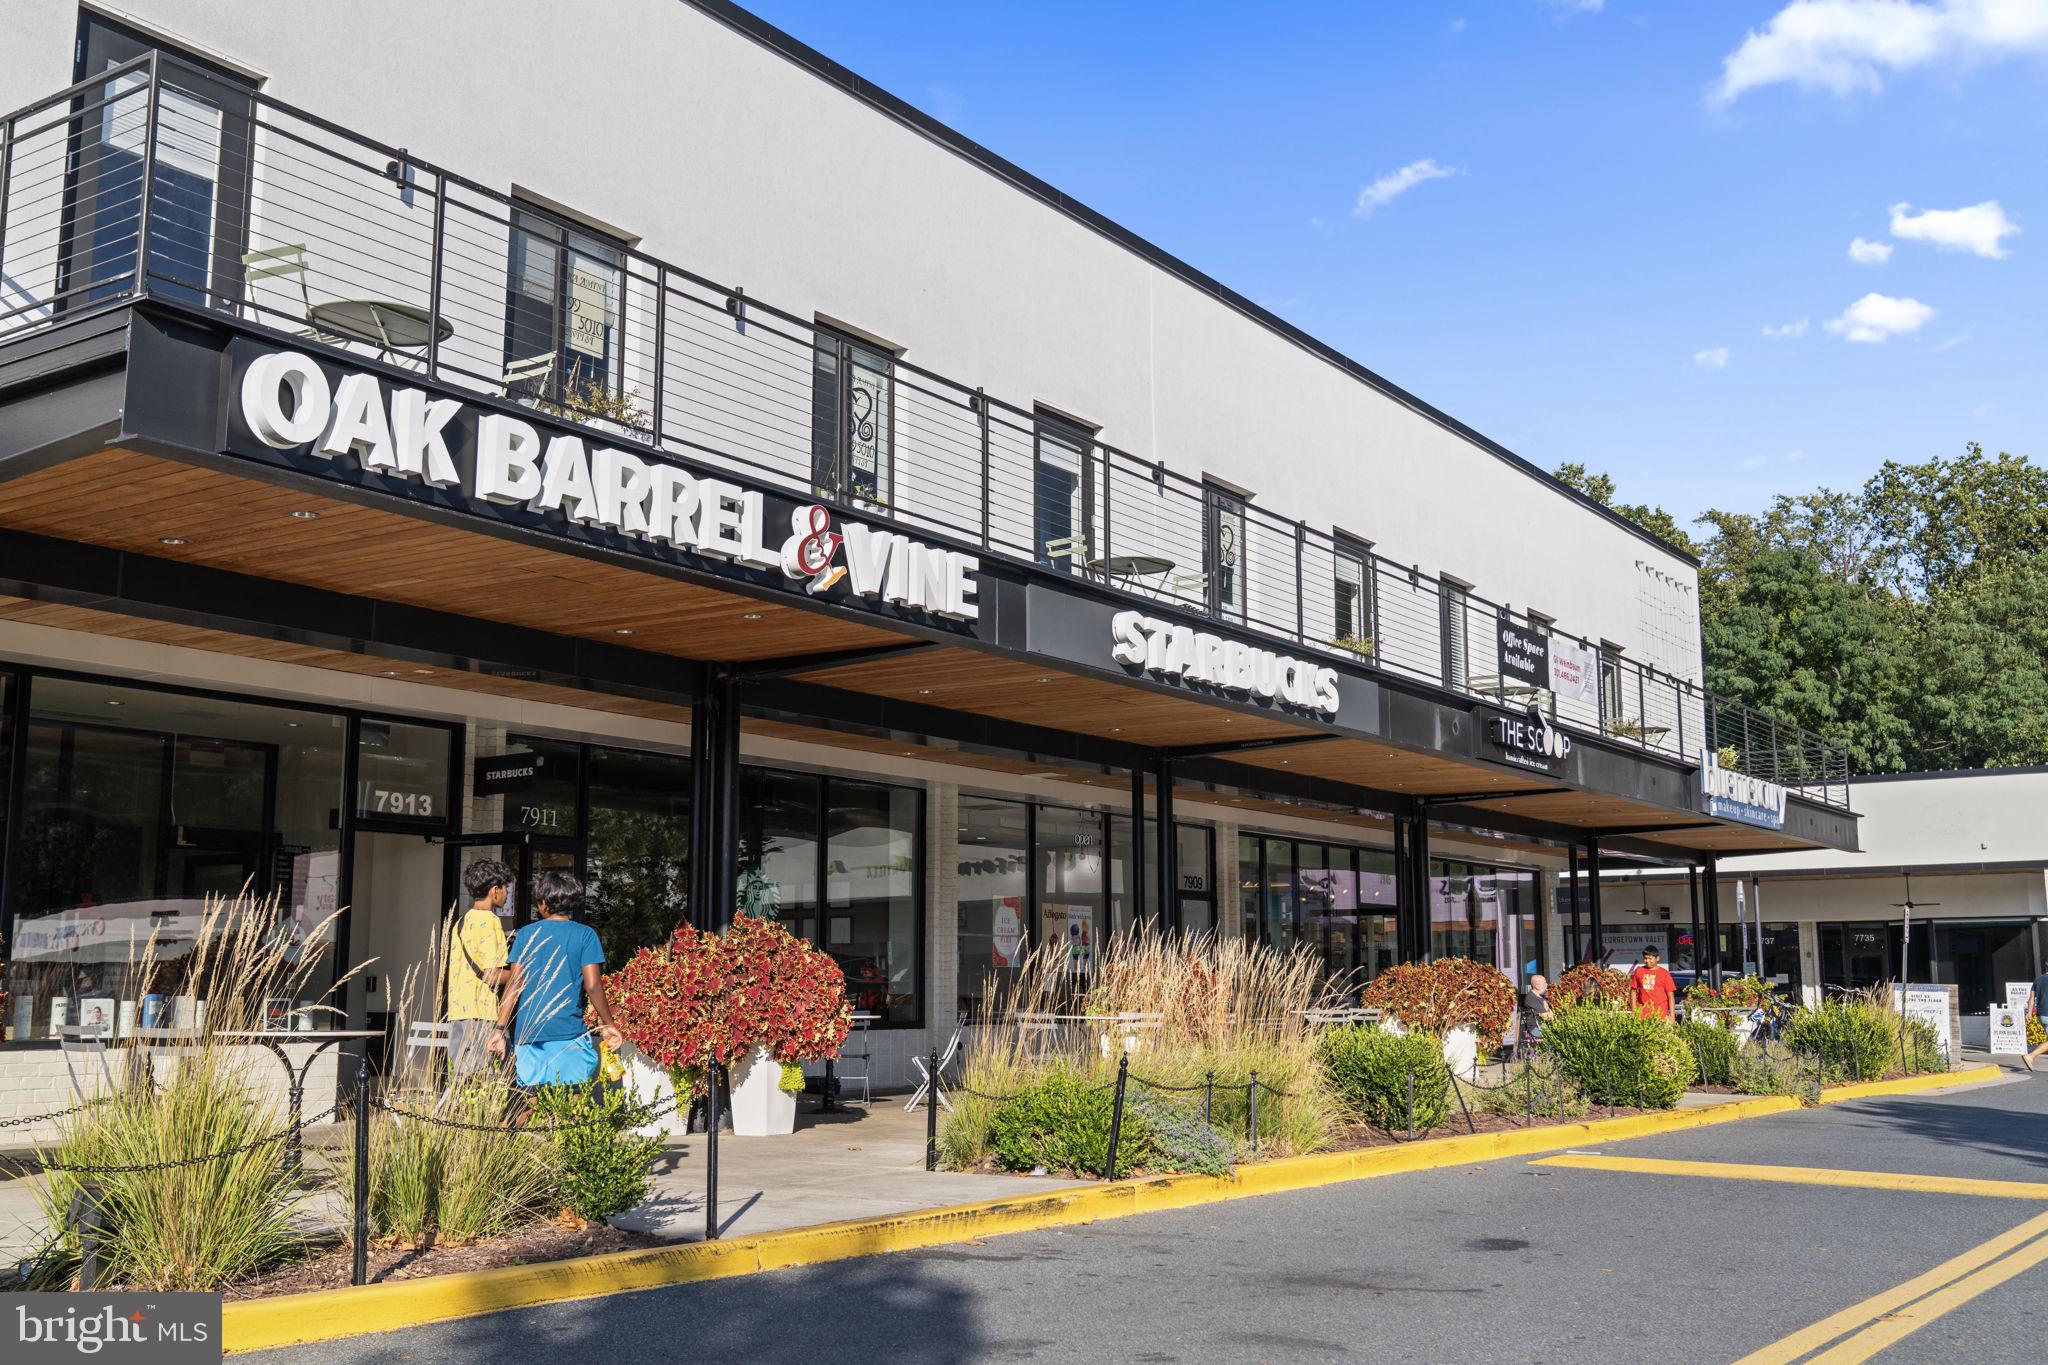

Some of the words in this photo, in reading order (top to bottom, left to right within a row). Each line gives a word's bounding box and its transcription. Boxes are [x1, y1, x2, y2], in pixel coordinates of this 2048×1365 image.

[241, 351, 463, 487] OAK
[476, 414, 781, 569] BARREL
[781, 503, 847, 595] &
[840, 521, 980, 620] VINE
[1523, 639, 1545, 657] Space
[1112, 610, 1340, 714] STARBUCKS
[1503, 651, 1536, 673] Available
[1499, 717, 1524, 748] THE
[1528, 725, 1571, 759] SCOOP
[486, 767, 534, 781] STARBUCKS
[375, 790, 433, 817] 7913
[1717, 801, 1740, 819] makeup
[1744, 805, 1768, 822] skincare
[520, 806, 558, 827] 7911
[1183, 875, 1203, 890] 7909
[1645, 935, 1665, 943] VALET
[1854, 934, 1875, 943] 7735
